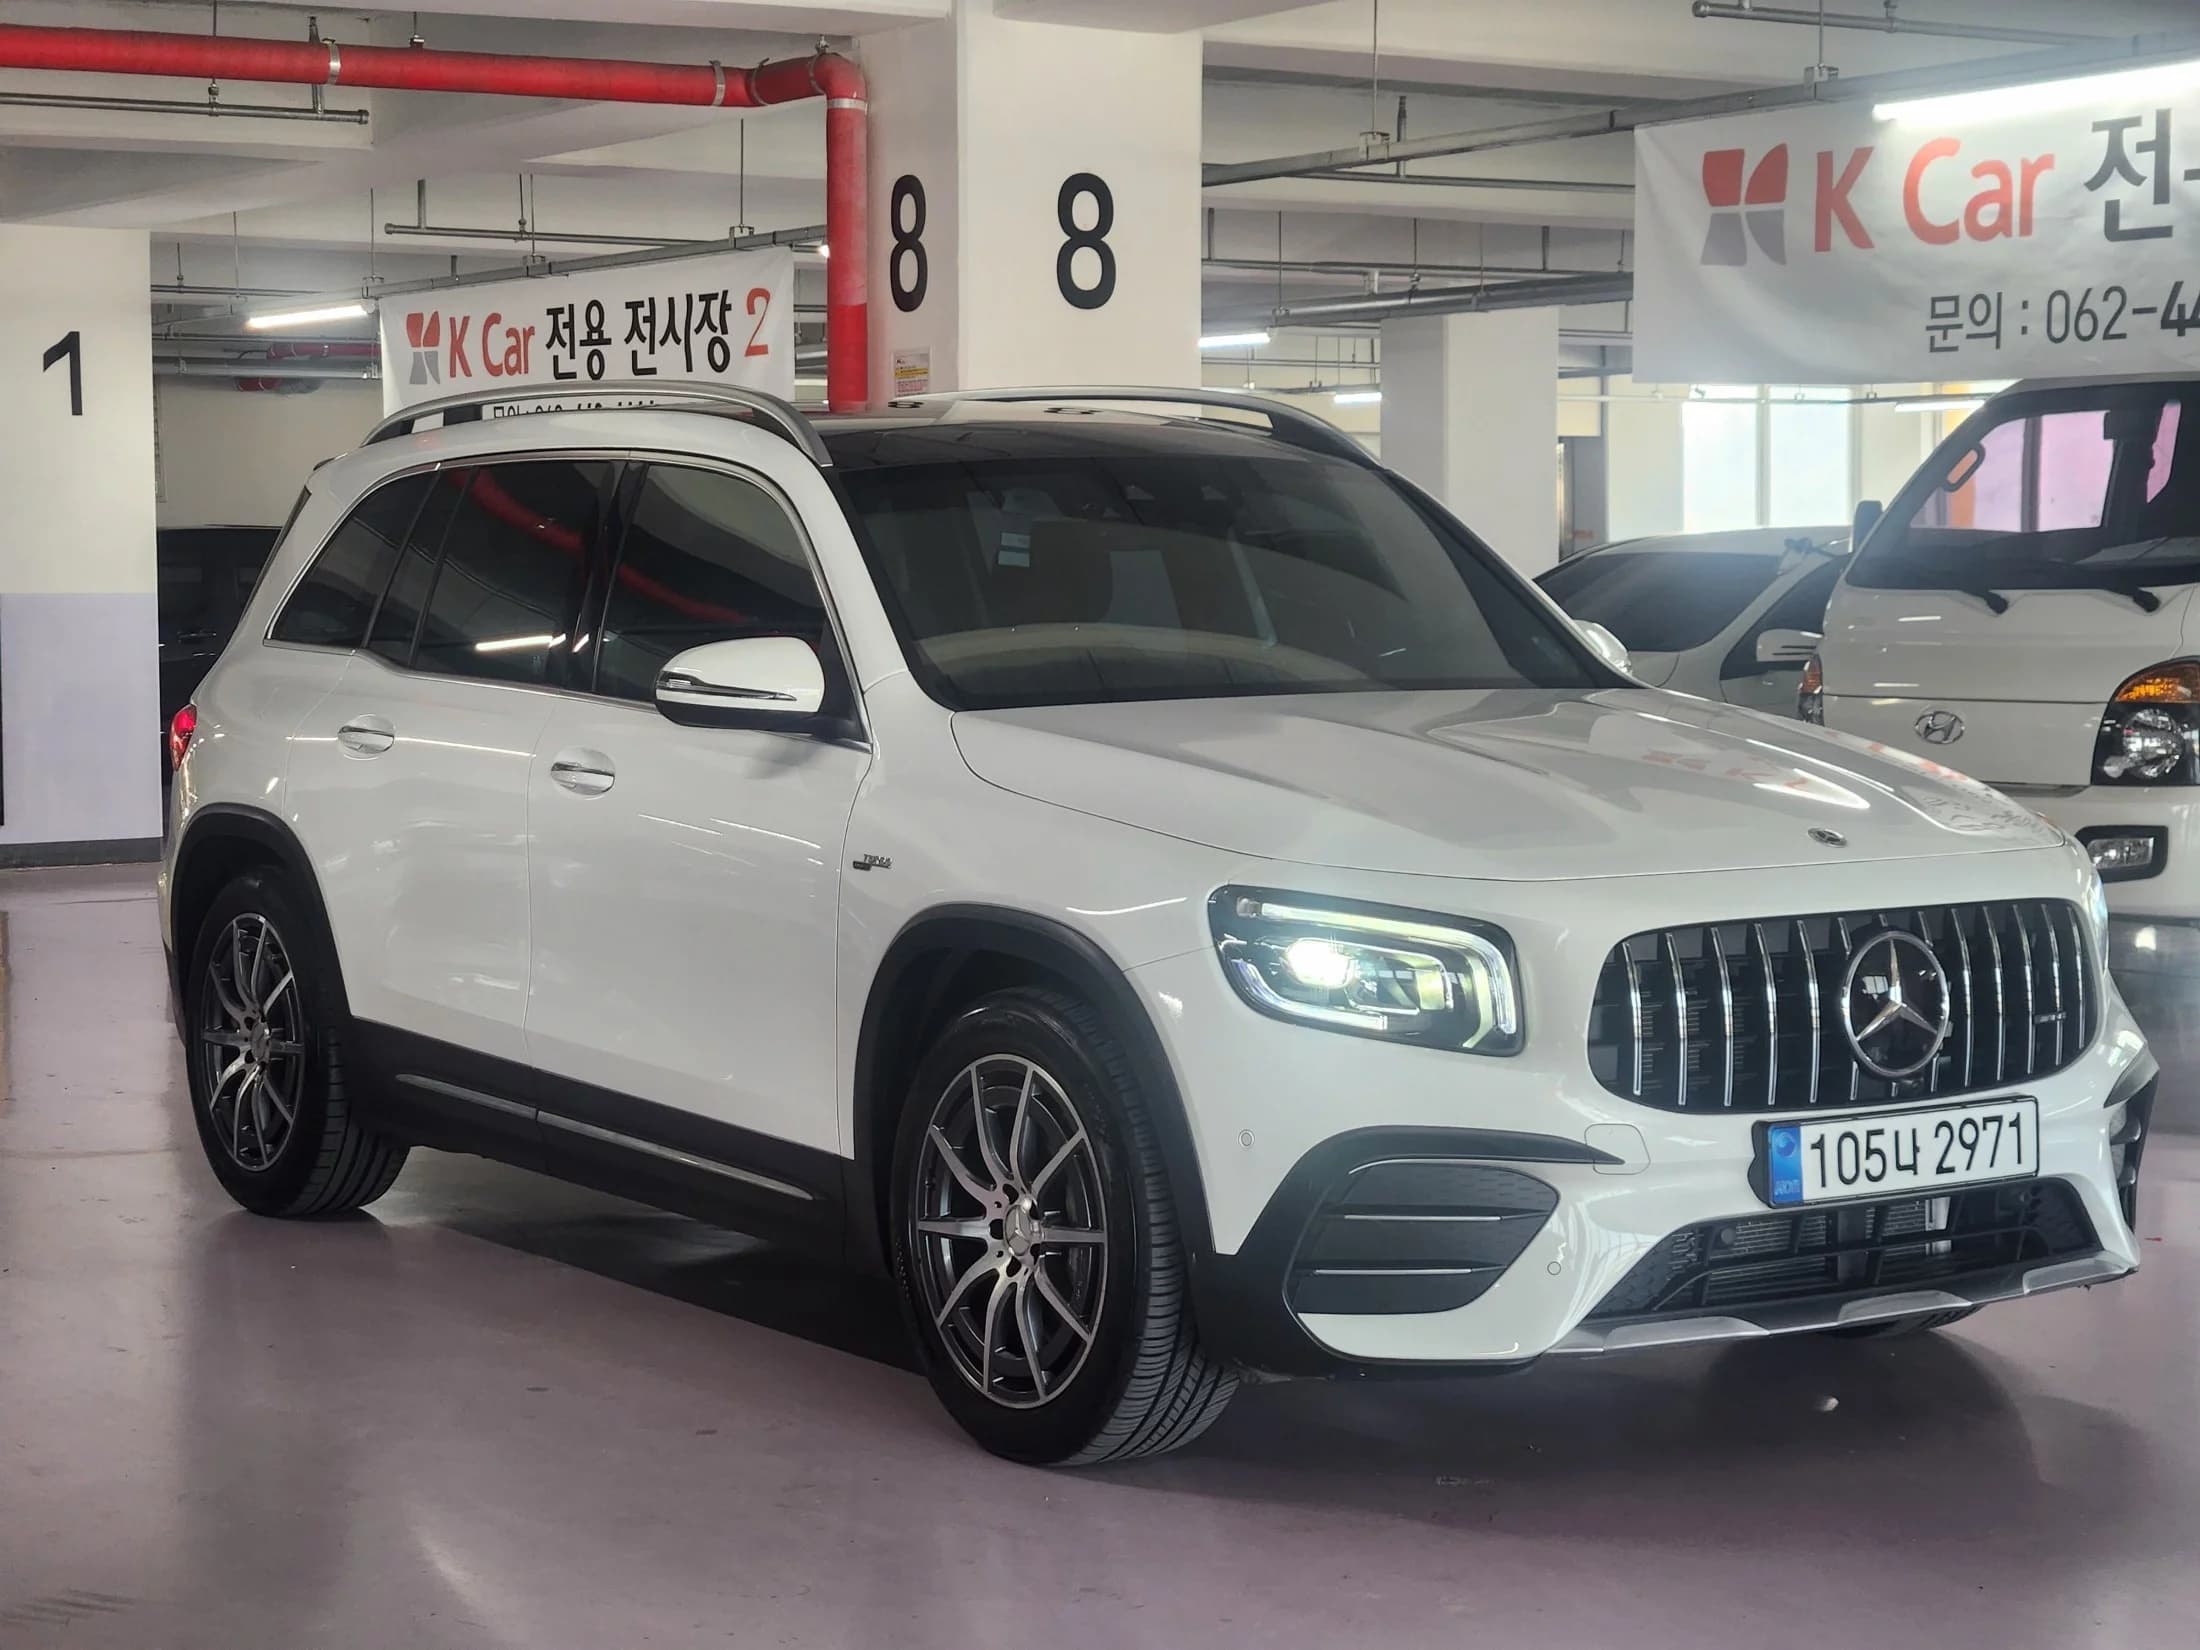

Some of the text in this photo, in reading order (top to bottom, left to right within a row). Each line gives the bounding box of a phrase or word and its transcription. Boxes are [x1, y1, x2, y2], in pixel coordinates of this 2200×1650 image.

[1813, 108, 2200, 253] K Car 전
[890, 174, 928, 313] 8
[1056, 172, 1117, 310] 8
[42, 331, 83, 416] 1
[448, 287, 772, 381] K Car 전용 전시장 2
[1809, 1112, 2023, 1188] 105나 2971
